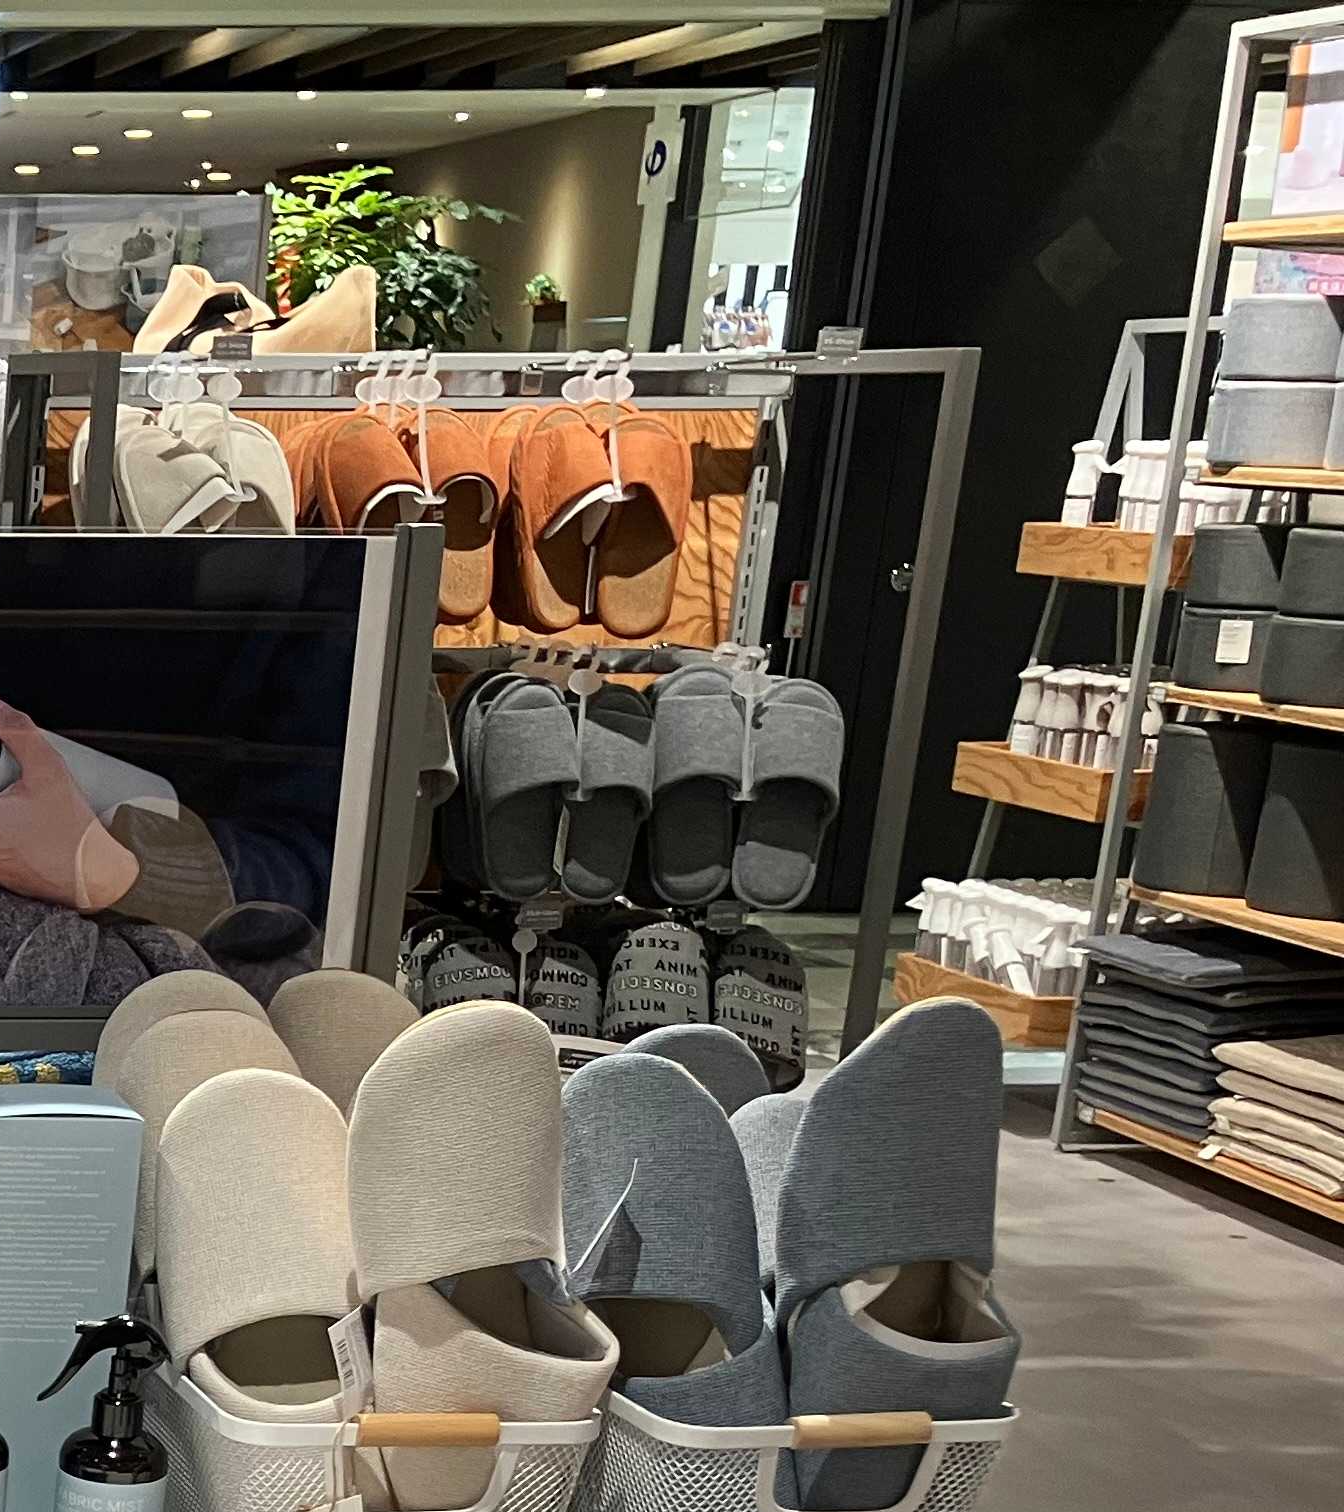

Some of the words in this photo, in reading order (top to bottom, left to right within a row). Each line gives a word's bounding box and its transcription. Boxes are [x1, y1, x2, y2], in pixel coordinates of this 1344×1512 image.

[655, 959, 698, 977] ANIM
[61, 1488, 102, 1511] ABRIC
[107, 1496, 144, 1512] MIST
